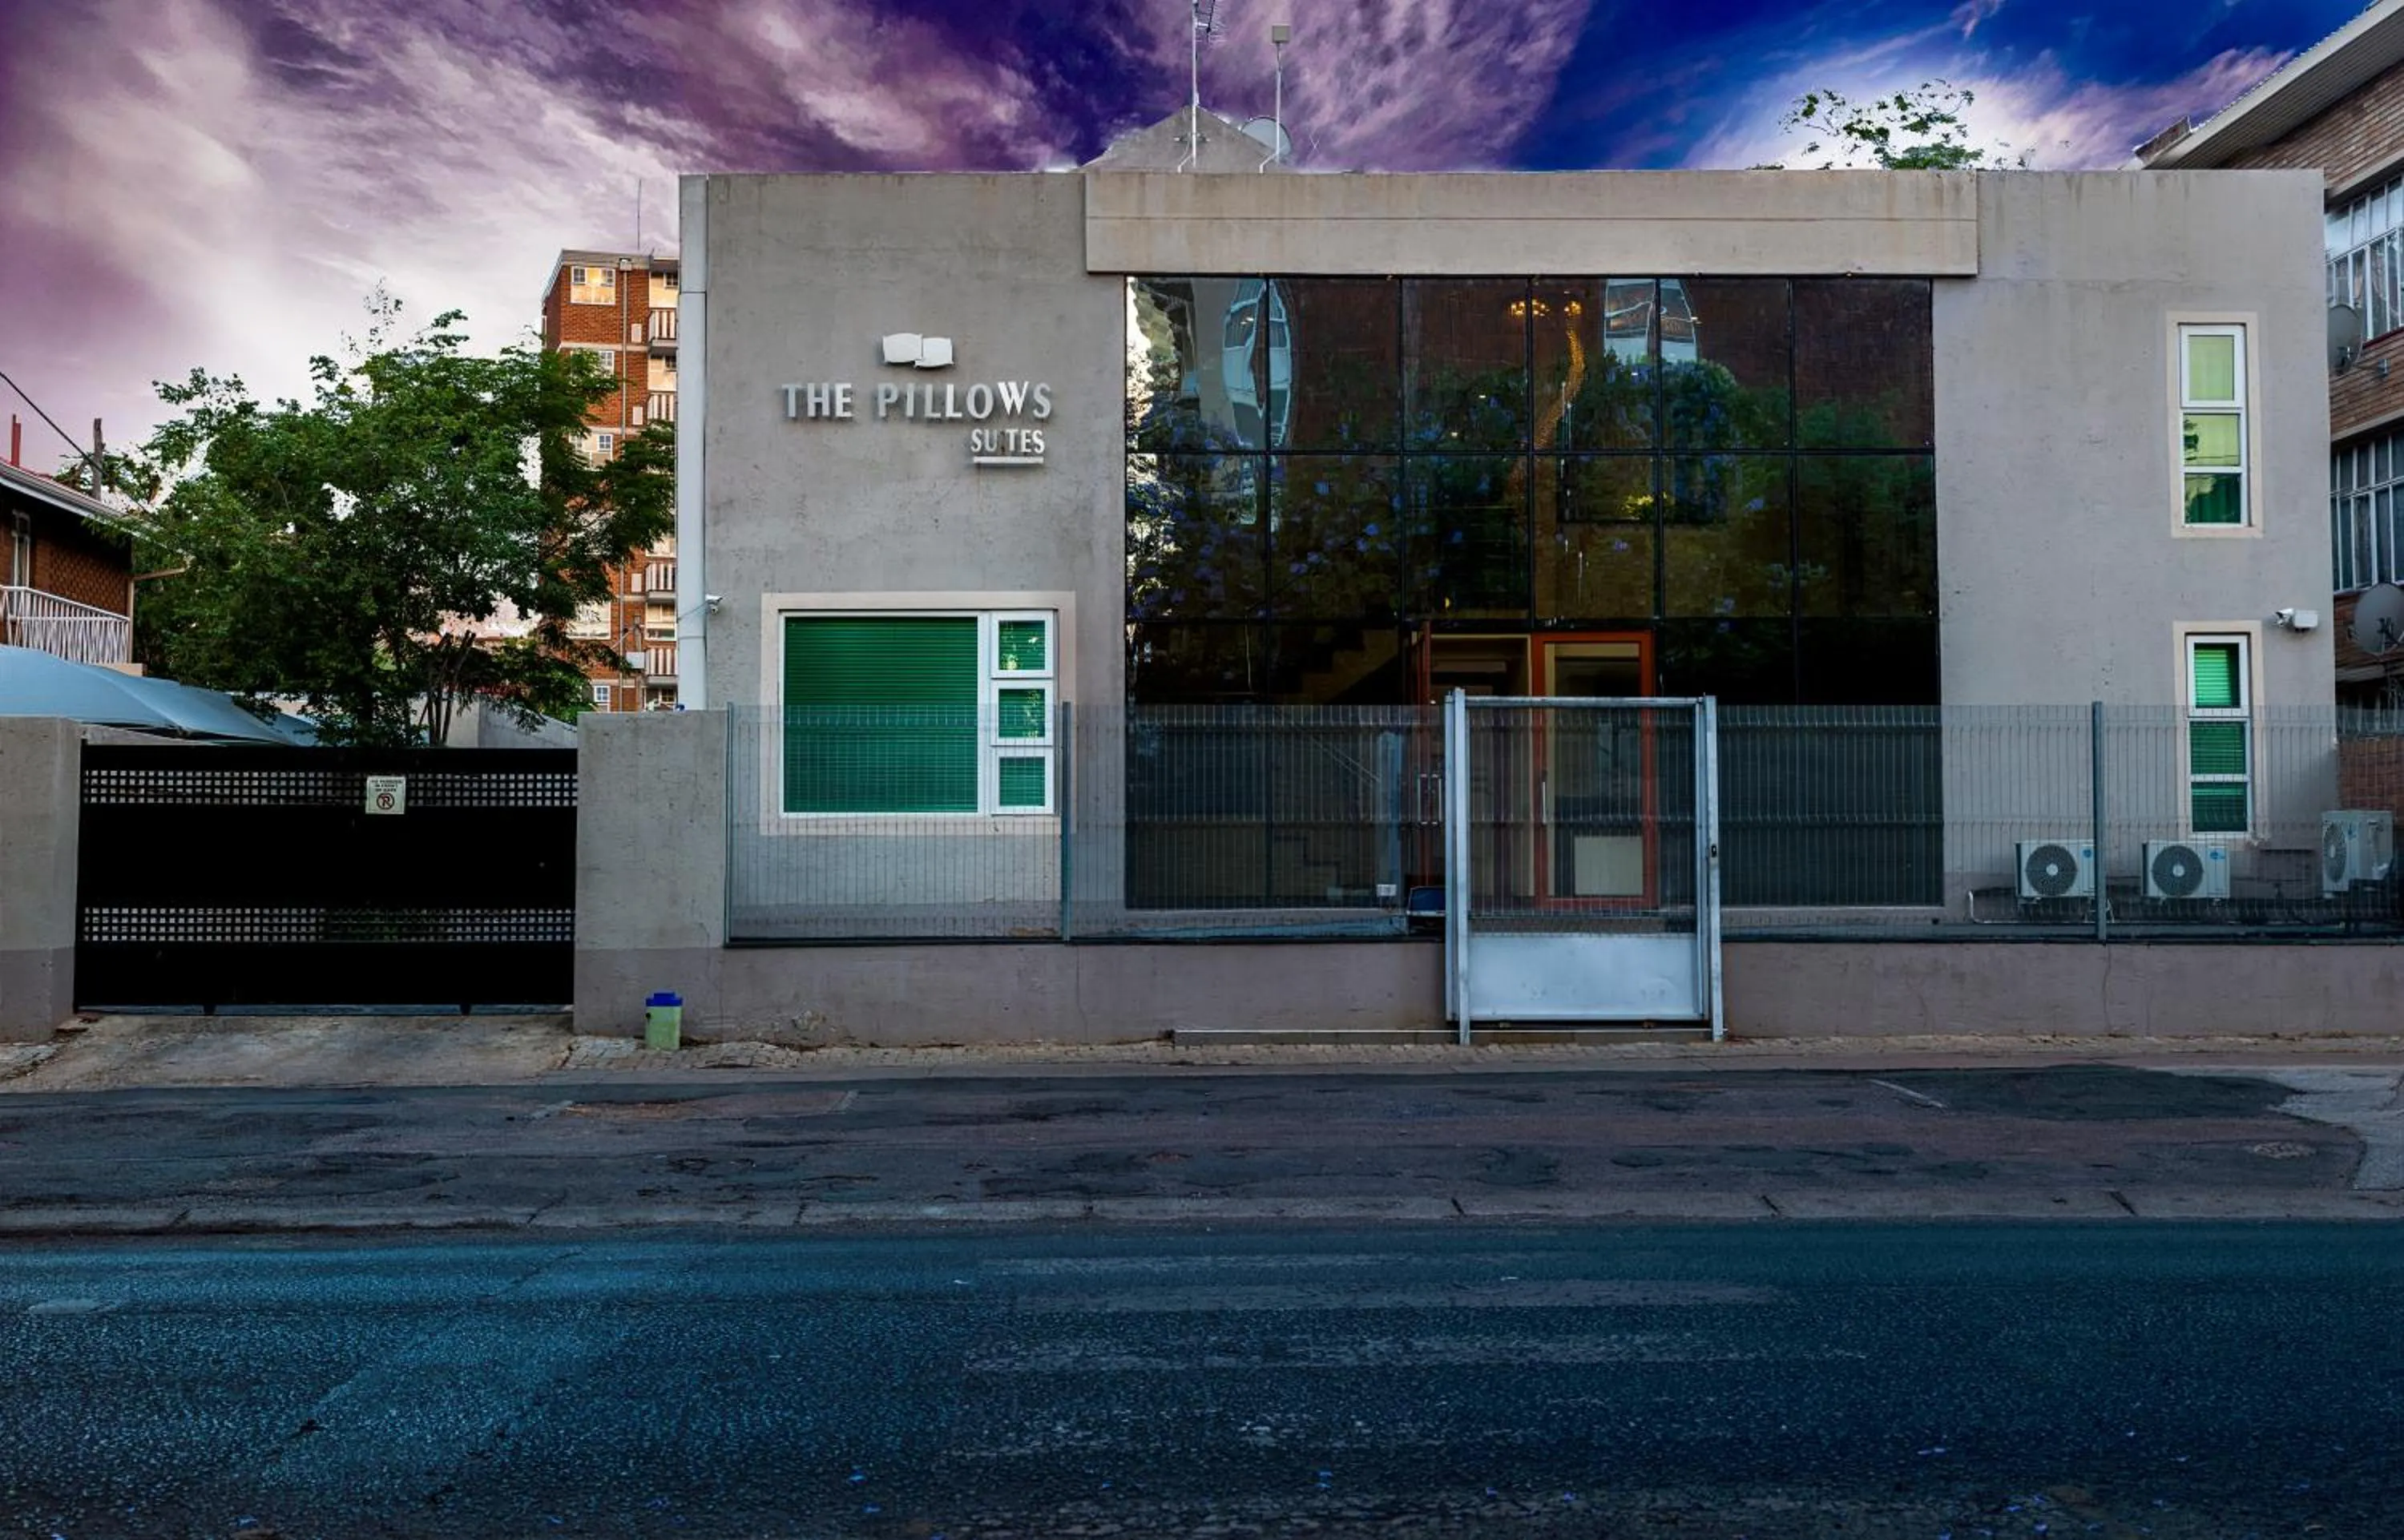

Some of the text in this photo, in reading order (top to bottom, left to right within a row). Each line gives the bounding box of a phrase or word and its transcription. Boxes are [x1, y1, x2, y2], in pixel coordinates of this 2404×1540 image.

[782, 381, 1052, 418] THE PILLOWS
[970, 428, 1046, 454] SUTES
